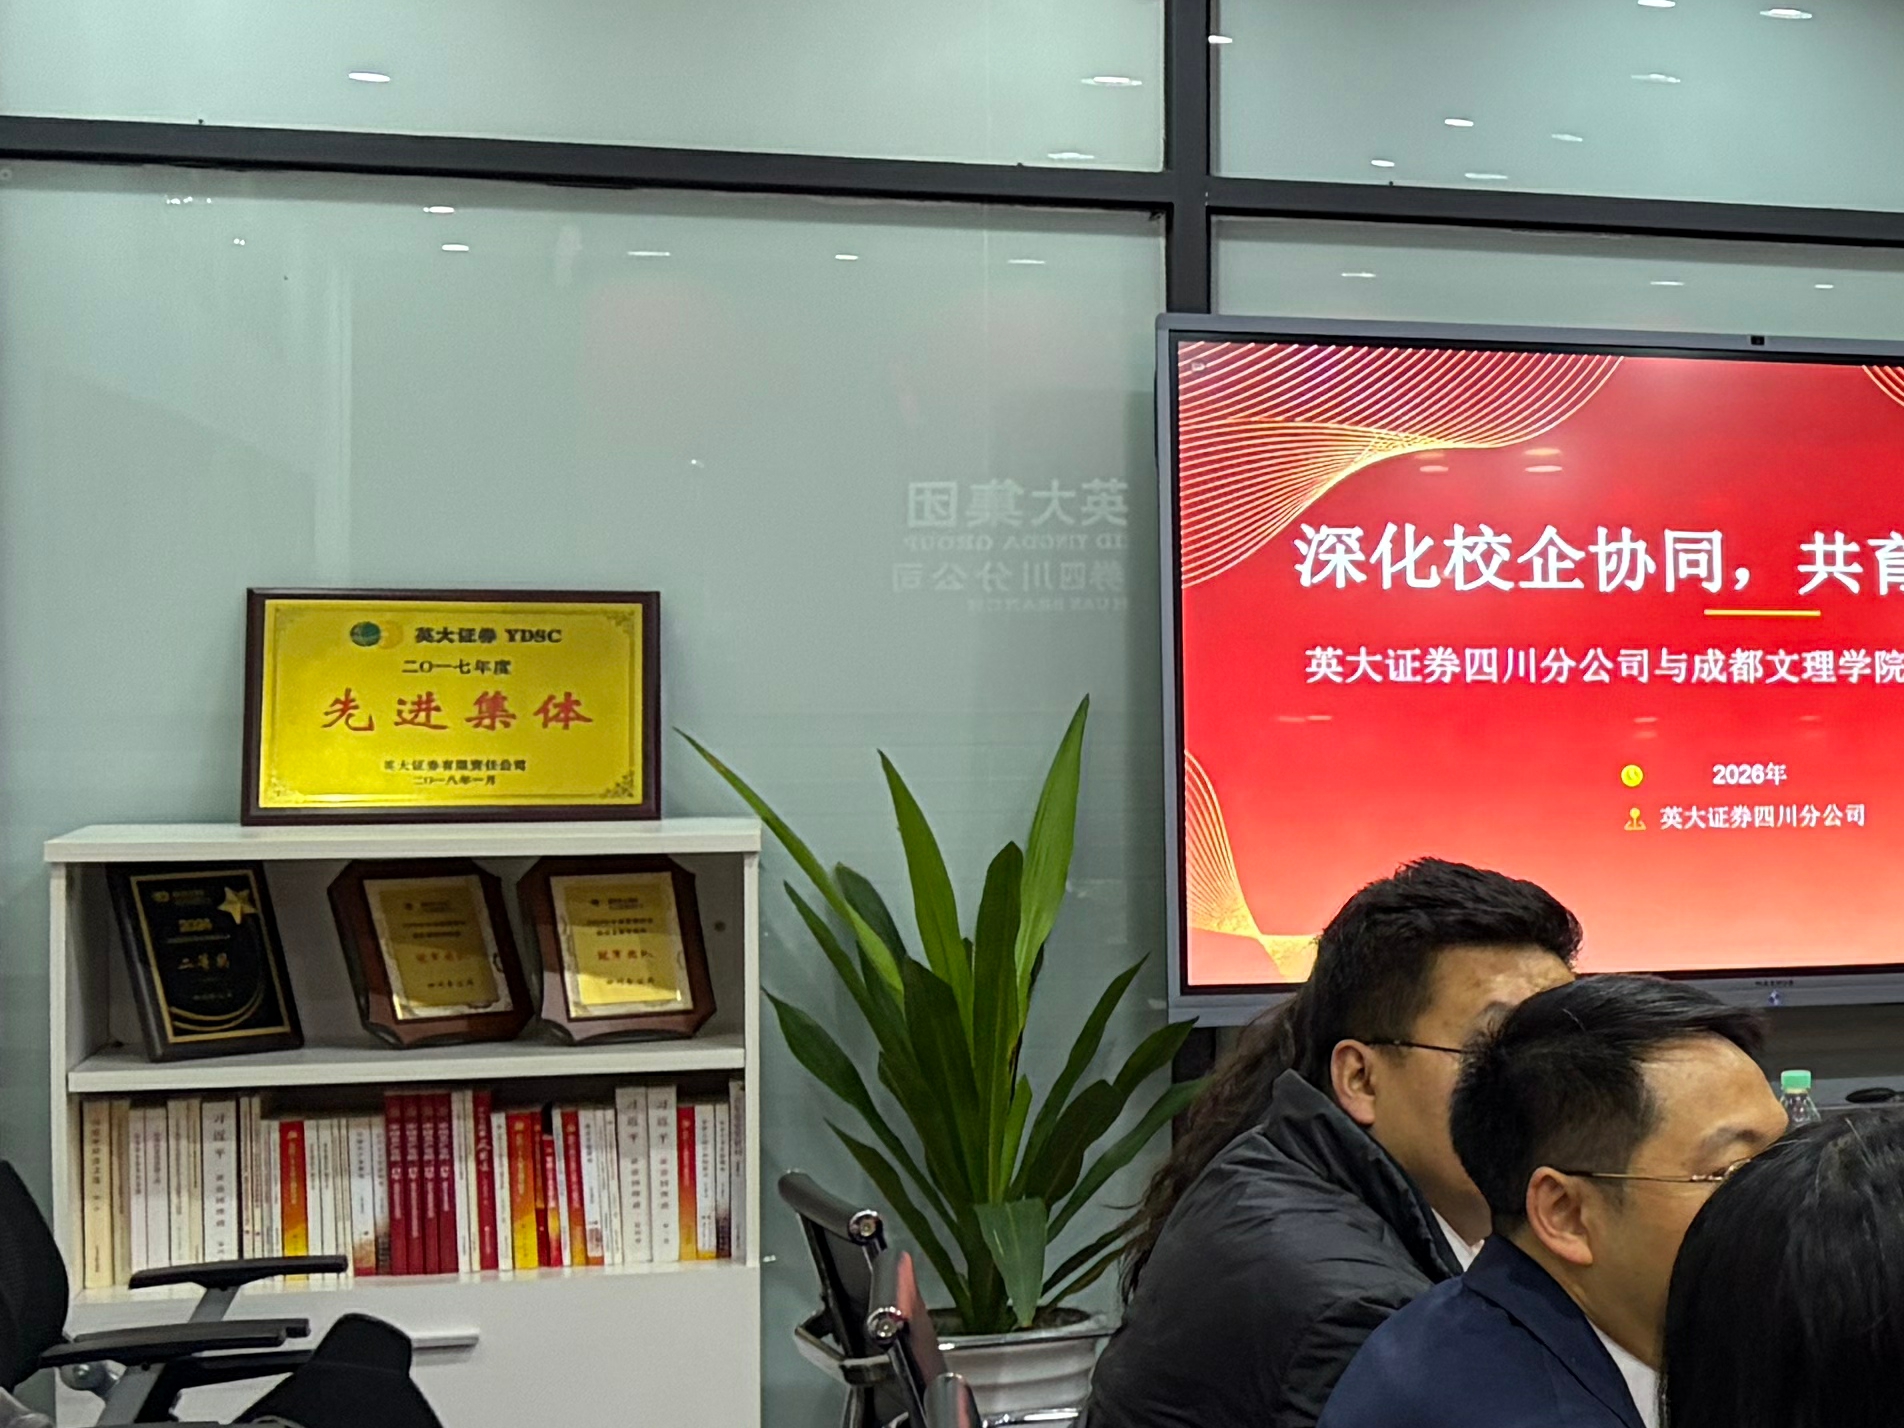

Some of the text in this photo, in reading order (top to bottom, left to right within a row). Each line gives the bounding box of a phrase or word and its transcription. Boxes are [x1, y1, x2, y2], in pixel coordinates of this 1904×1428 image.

[414, 627, 562, 645] 英大证券 YDSC
[321, 687, 593, 732] 先进集体
[1711, 760, 1788, 787] 2026年
[1659, 802, 1866, 832] 英大证券四川分公司
